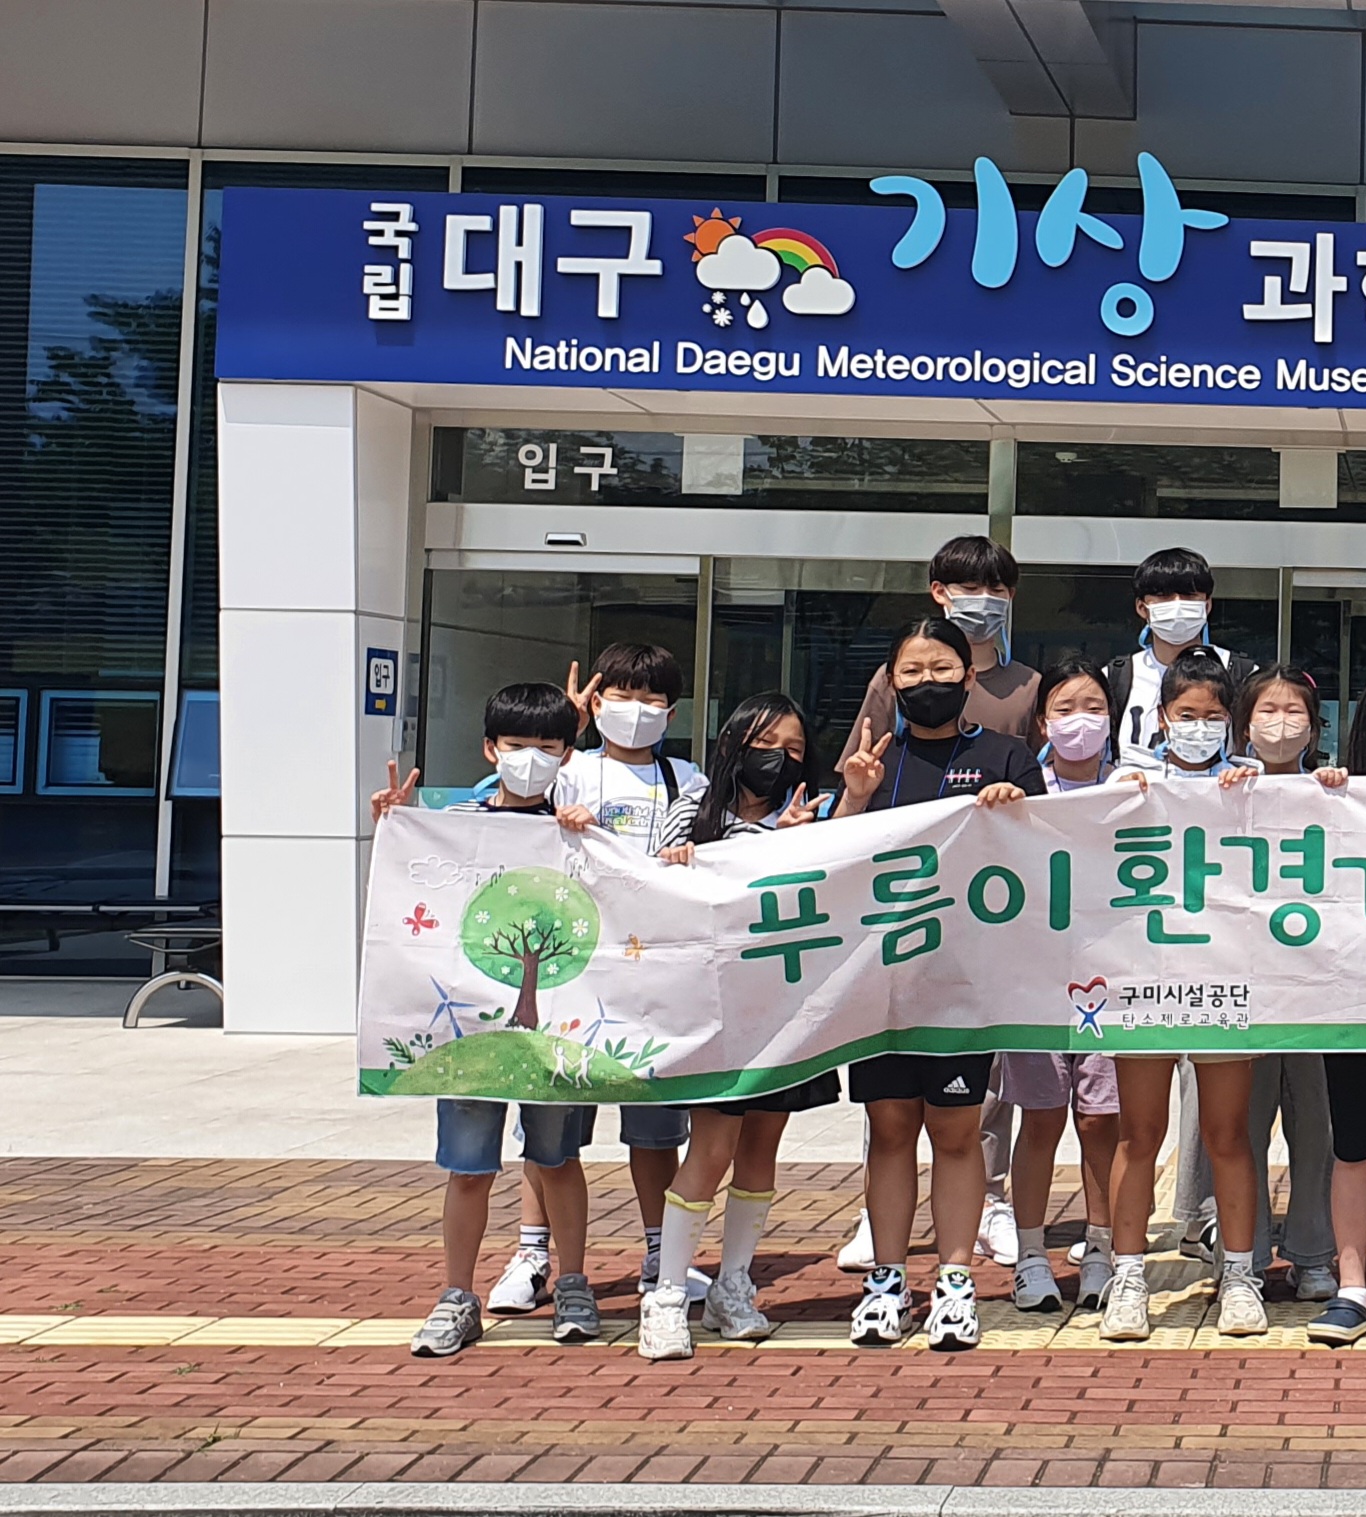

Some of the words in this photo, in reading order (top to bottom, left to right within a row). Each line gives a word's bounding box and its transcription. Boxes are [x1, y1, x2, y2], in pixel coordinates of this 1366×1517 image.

[362, 202, 419, 320] 국립
[443, 204, 663, 318] 대구
[869, 152, 1229, 336] 기상
[504, 337, 660, 373] National
[676, 341, 800, 382] Daegu
[817, 345, 1096, 389] Meteorological
[1110, 354, 1261, 390] Science
[517, 442, 618, 491] 입구
[374, 663, 391, 688] 입구
[741, 844, 1071, 983] 푸름이
[1119, 984, 1250, 1008] 구미시설공단
[1122, 1012, 1249, 1029] 탄소제로교육관
